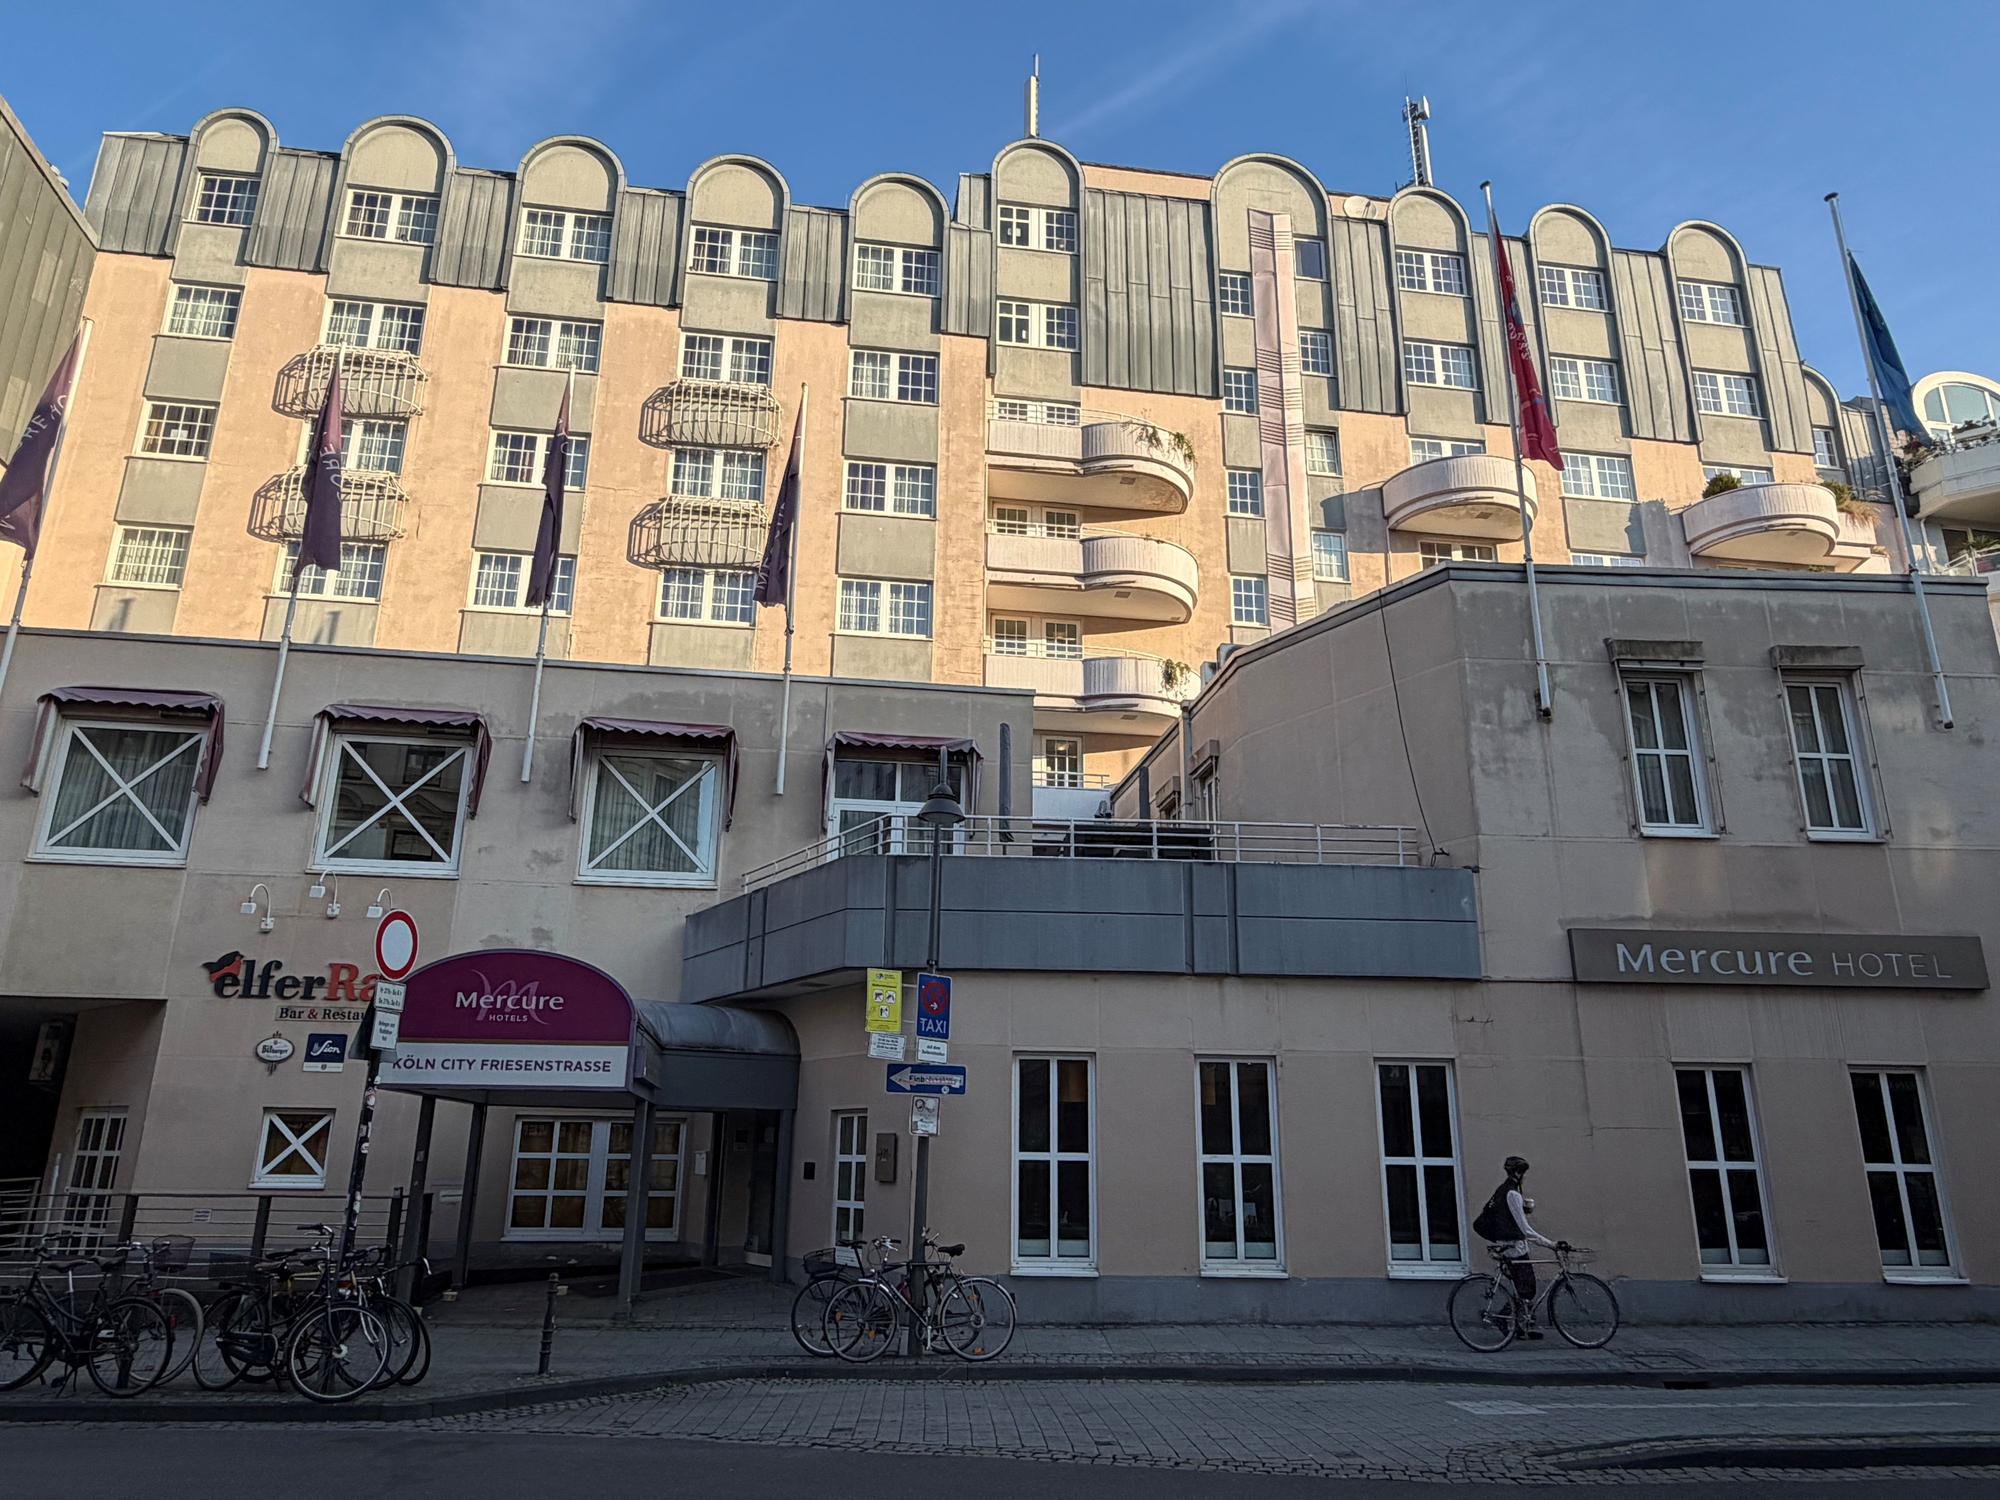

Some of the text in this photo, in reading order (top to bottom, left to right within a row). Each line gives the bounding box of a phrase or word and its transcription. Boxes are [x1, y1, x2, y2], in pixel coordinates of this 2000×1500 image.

[1615, 942, 1953, 979] Mercure HOTEL
[213, 958, 377, 1001] elferRa
[455, 990, 565, 1011] Mercure
[279, 1007, 304, 1019] Bar
[307, 1008, 318, 1019] &
[488, 1013, 528, 1023] HOTELS
[919, 1017, 947, 1034] TAXI
[392, 1054, 612, 1073] KÖLN CITY FRIESENSTRASSE
